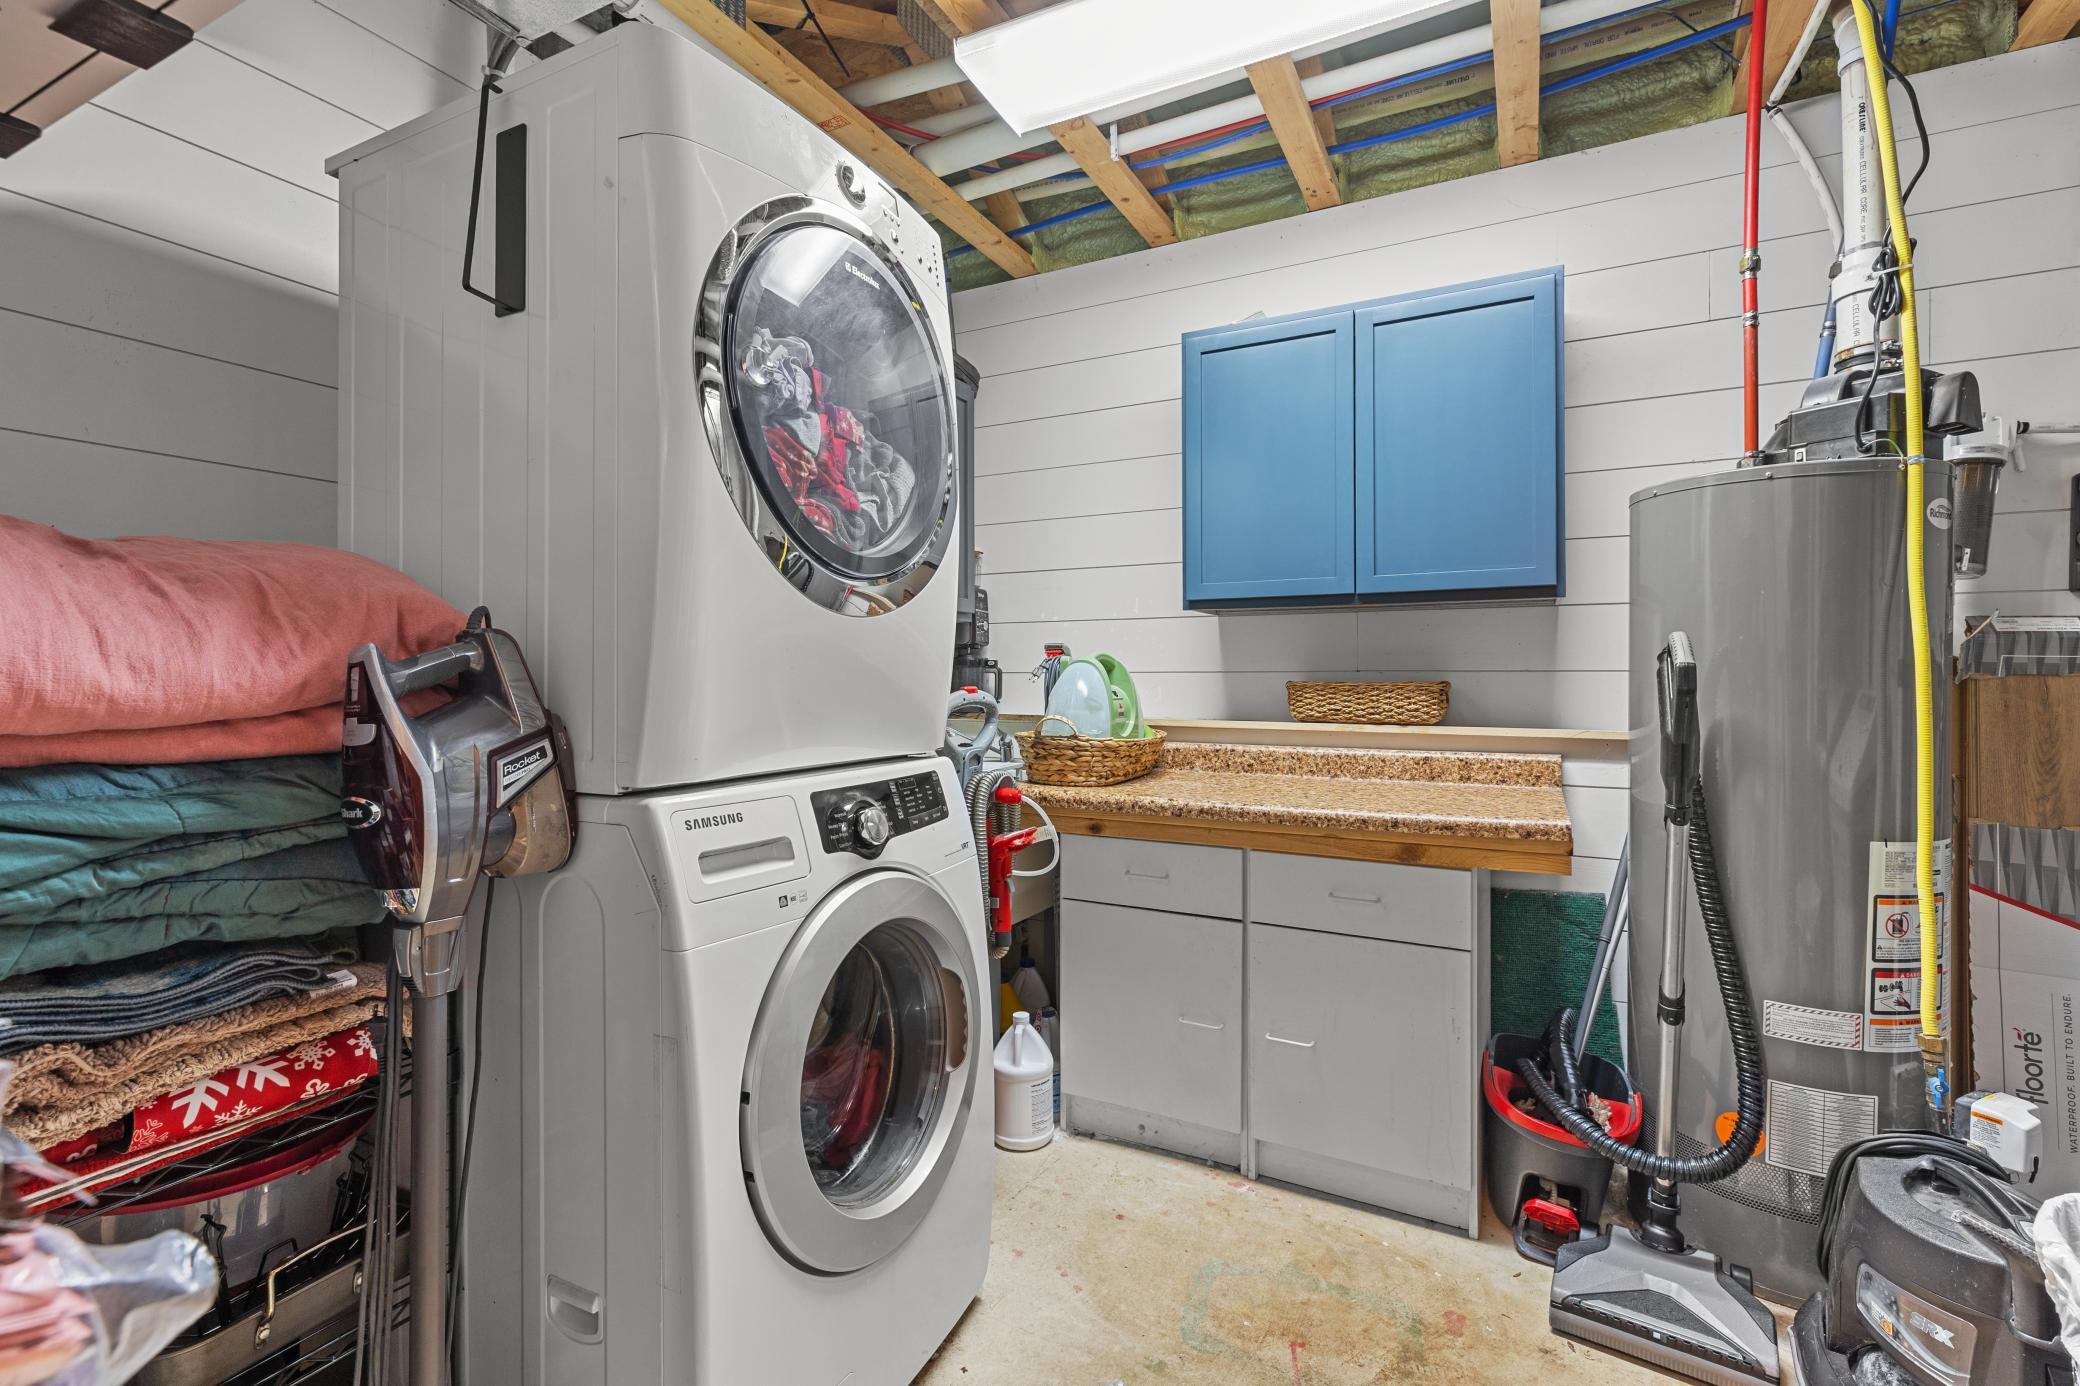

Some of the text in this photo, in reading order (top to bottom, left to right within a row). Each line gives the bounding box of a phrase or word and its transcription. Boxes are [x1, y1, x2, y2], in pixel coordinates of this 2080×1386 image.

[1860, 160, 1868, 193] CELLULAR
[1860, 196, 1868, 214] CORE
[851, 265, 880, 290] Electrolux
[1852, 303, 1861, 337] CELLULAR
[504, 751, 541, 776] Rocket
[684, 812, 744, 831] SAMSUNG
[2063, 993, 2080, 1154] WATERPROOF. BUILT TO ENDURE.
[1909, 1311, 1955, 1350] SRX
